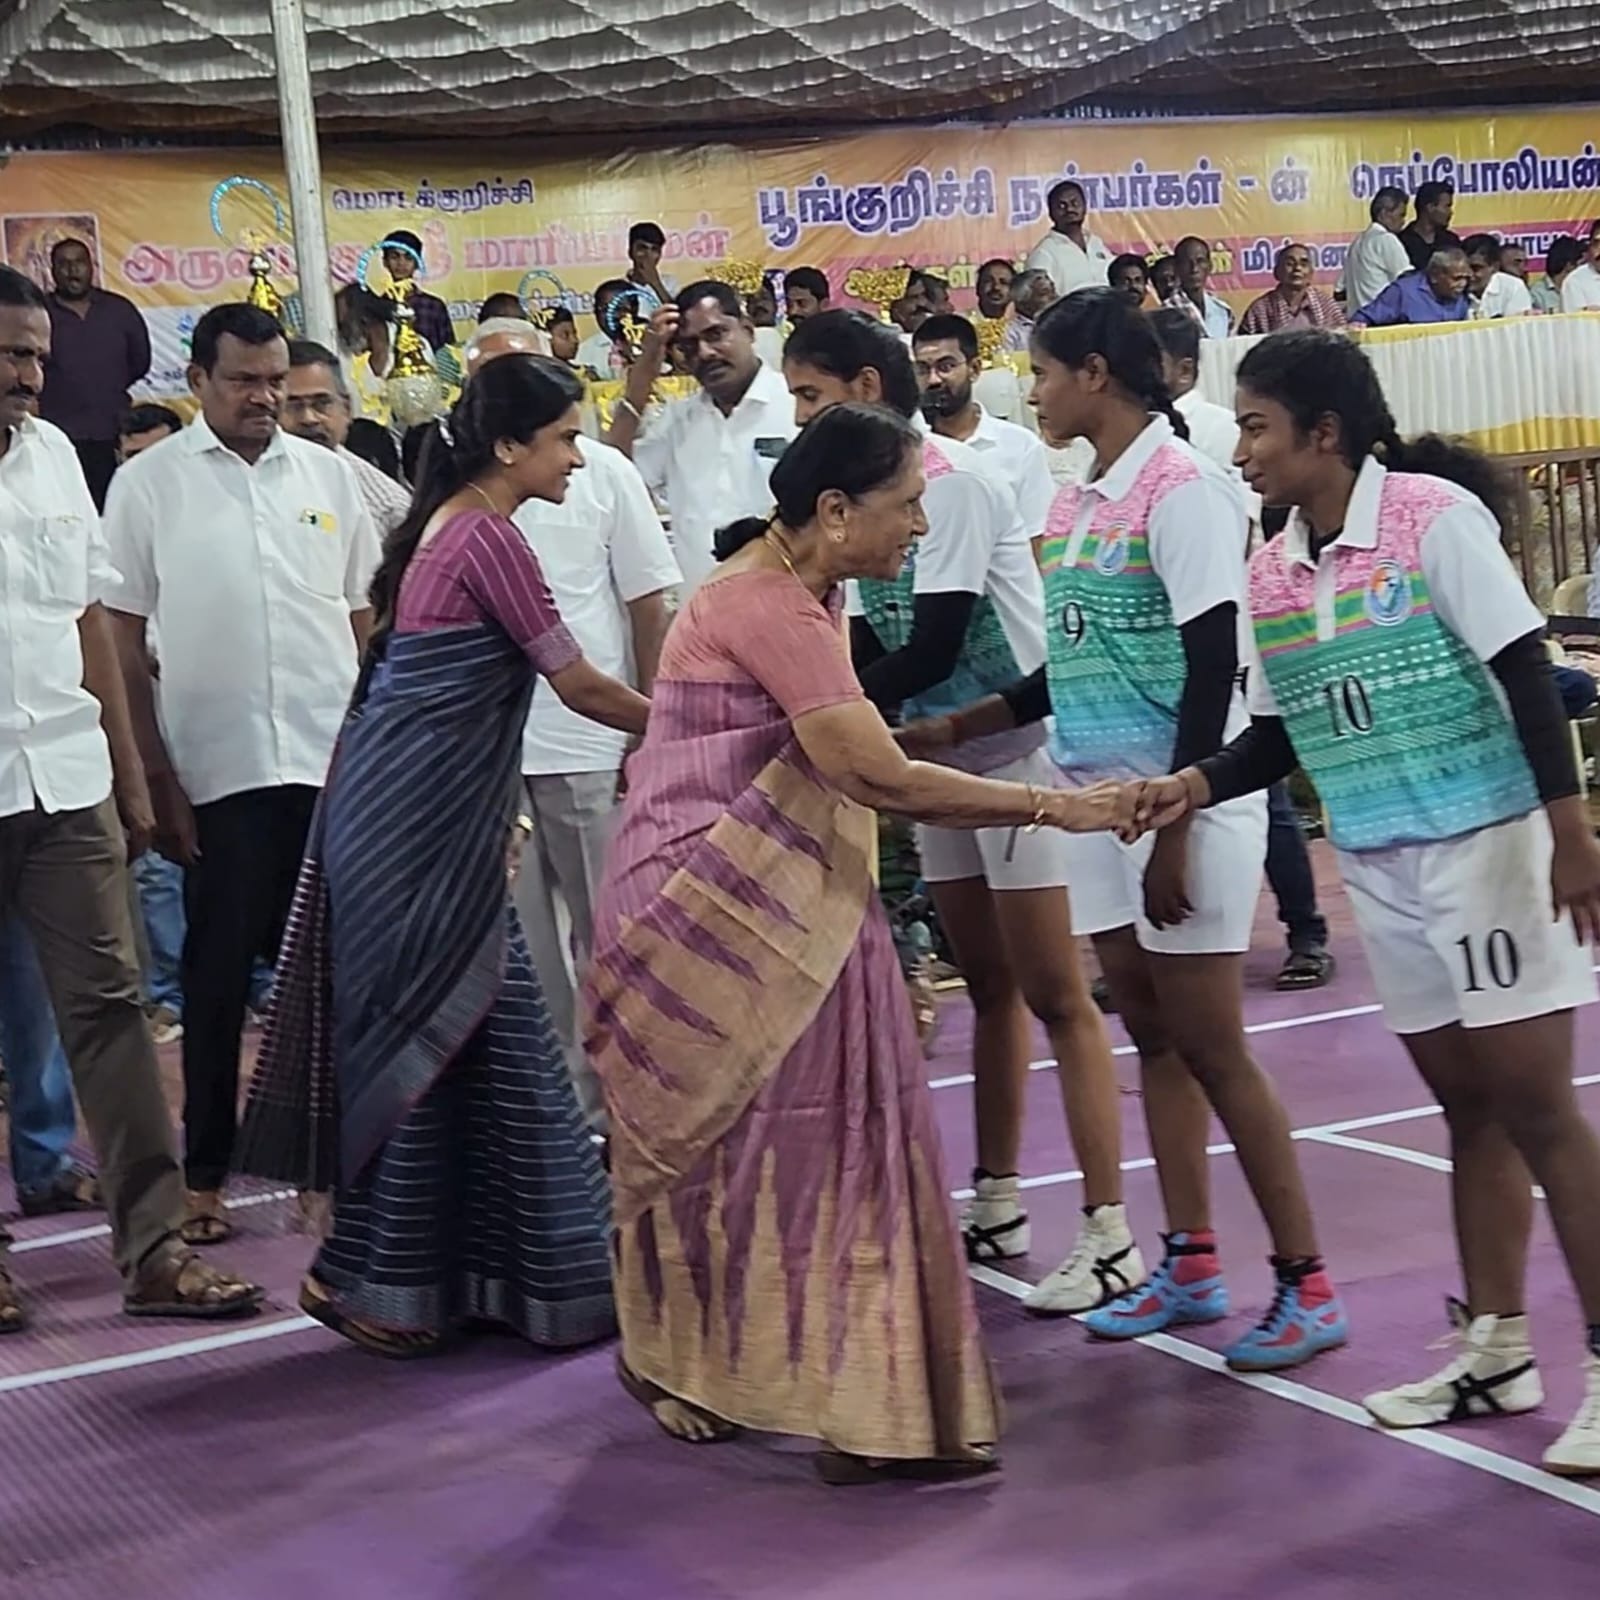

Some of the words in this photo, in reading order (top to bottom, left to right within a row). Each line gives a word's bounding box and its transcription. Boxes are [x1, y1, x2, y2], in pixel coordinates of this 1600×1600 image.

[758, 168, 994, 248] பூங்குறிச்சி
[1062, 601, 1084, 648] 9
[1321, 674, 1373, 737] 10
[1455, 928, 1520, 992] 10
